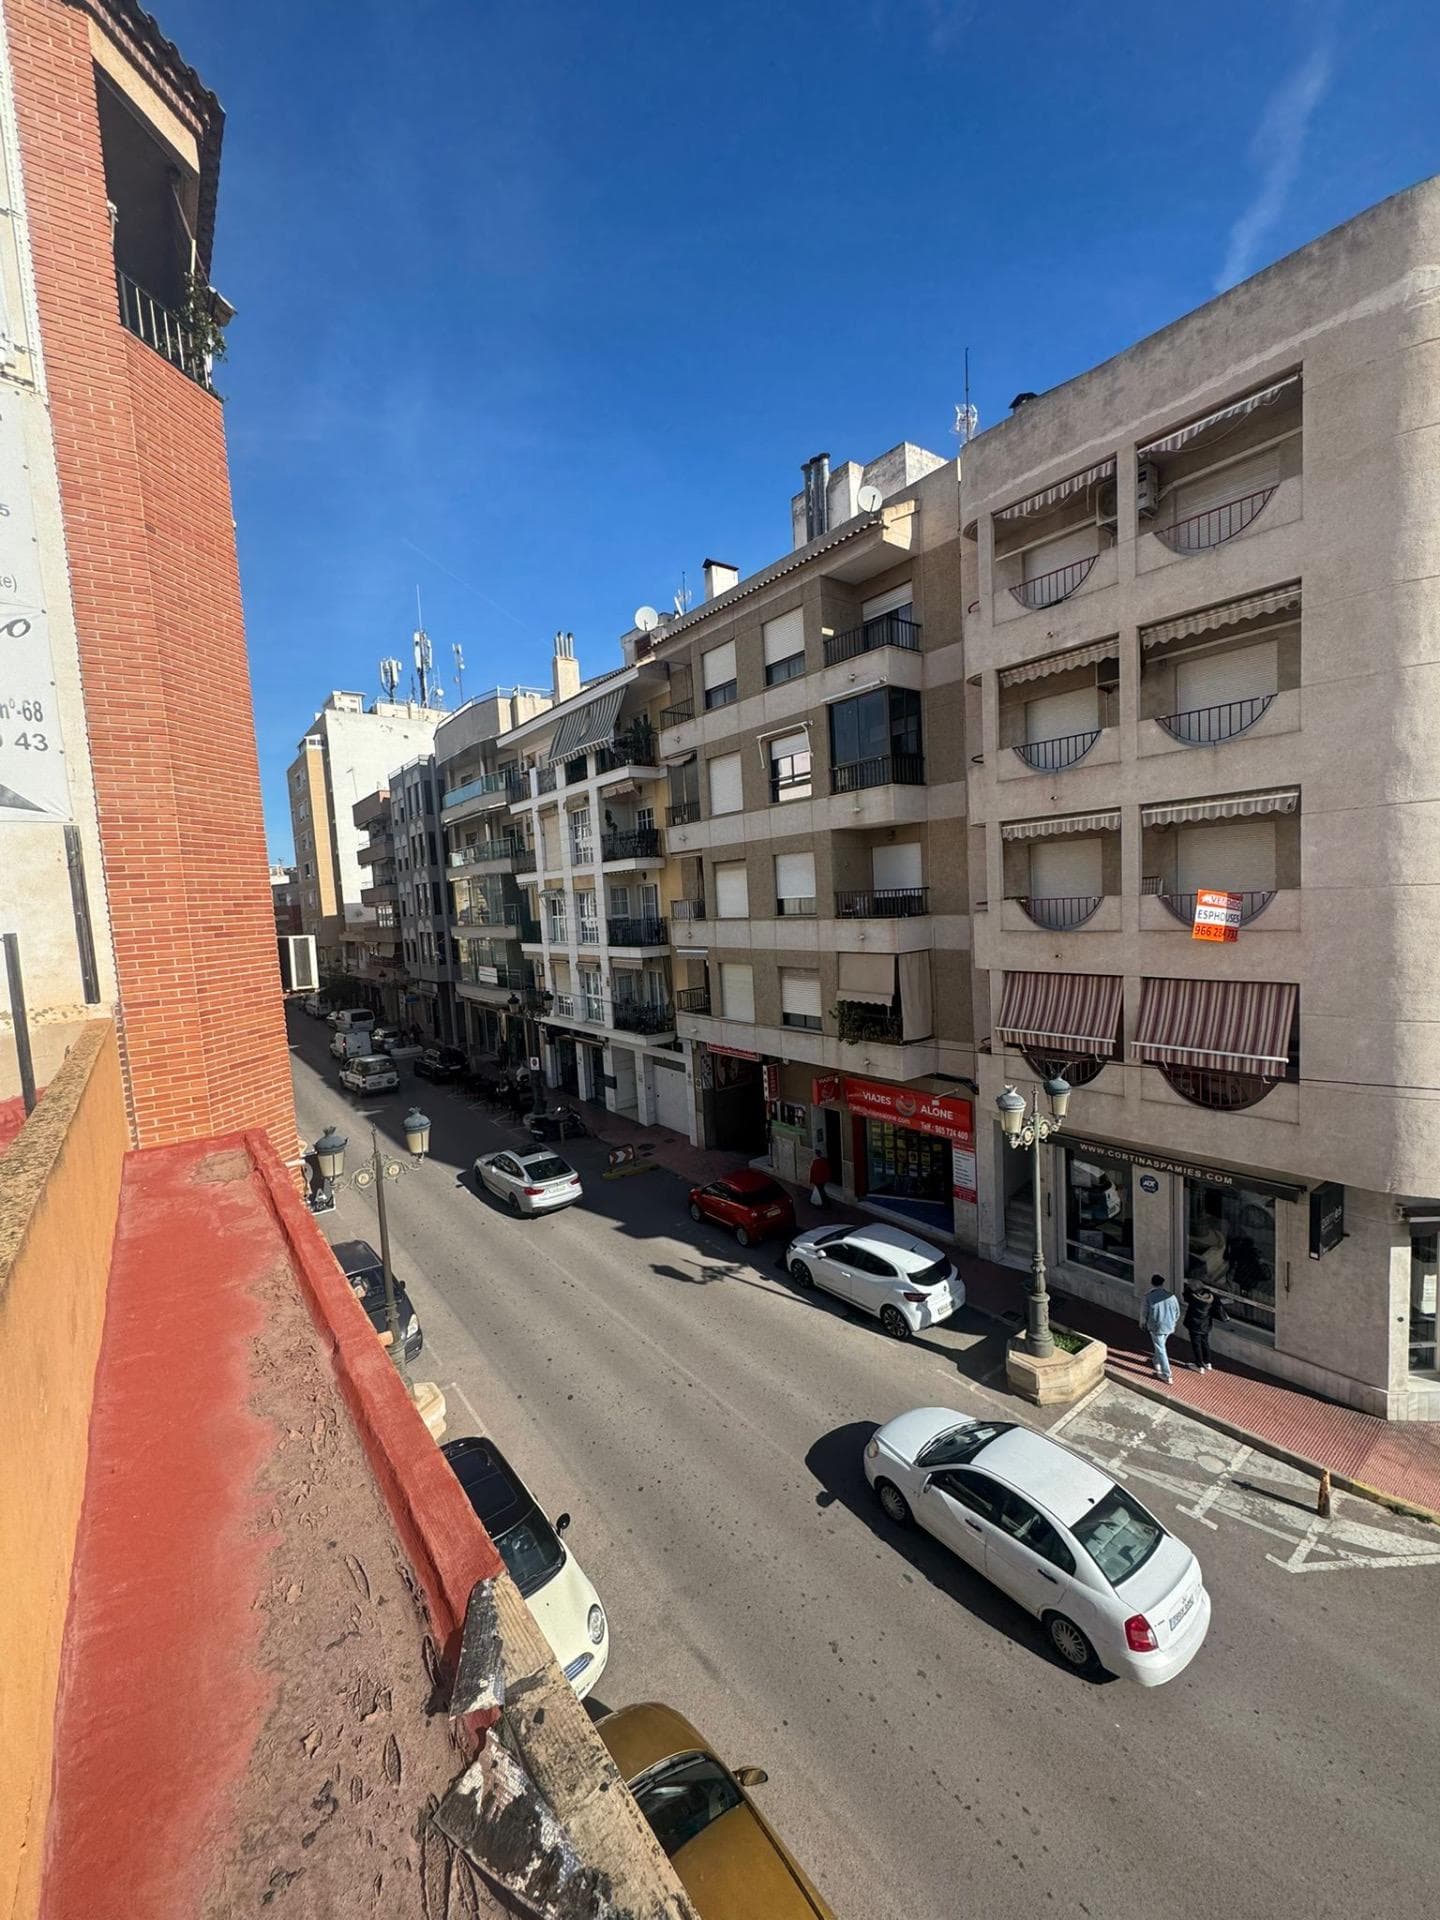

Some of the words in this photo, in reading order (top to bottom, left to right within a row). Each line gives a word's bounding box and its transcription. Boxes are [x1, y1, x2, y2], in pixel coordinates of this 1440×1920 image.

[863, 1091, 892, 1106] VIAJES
[920, 1105, 954, 1121] ALONE
[1079, 1143, 1233, 1186] WWW.CORTINASPAMIES.COM
